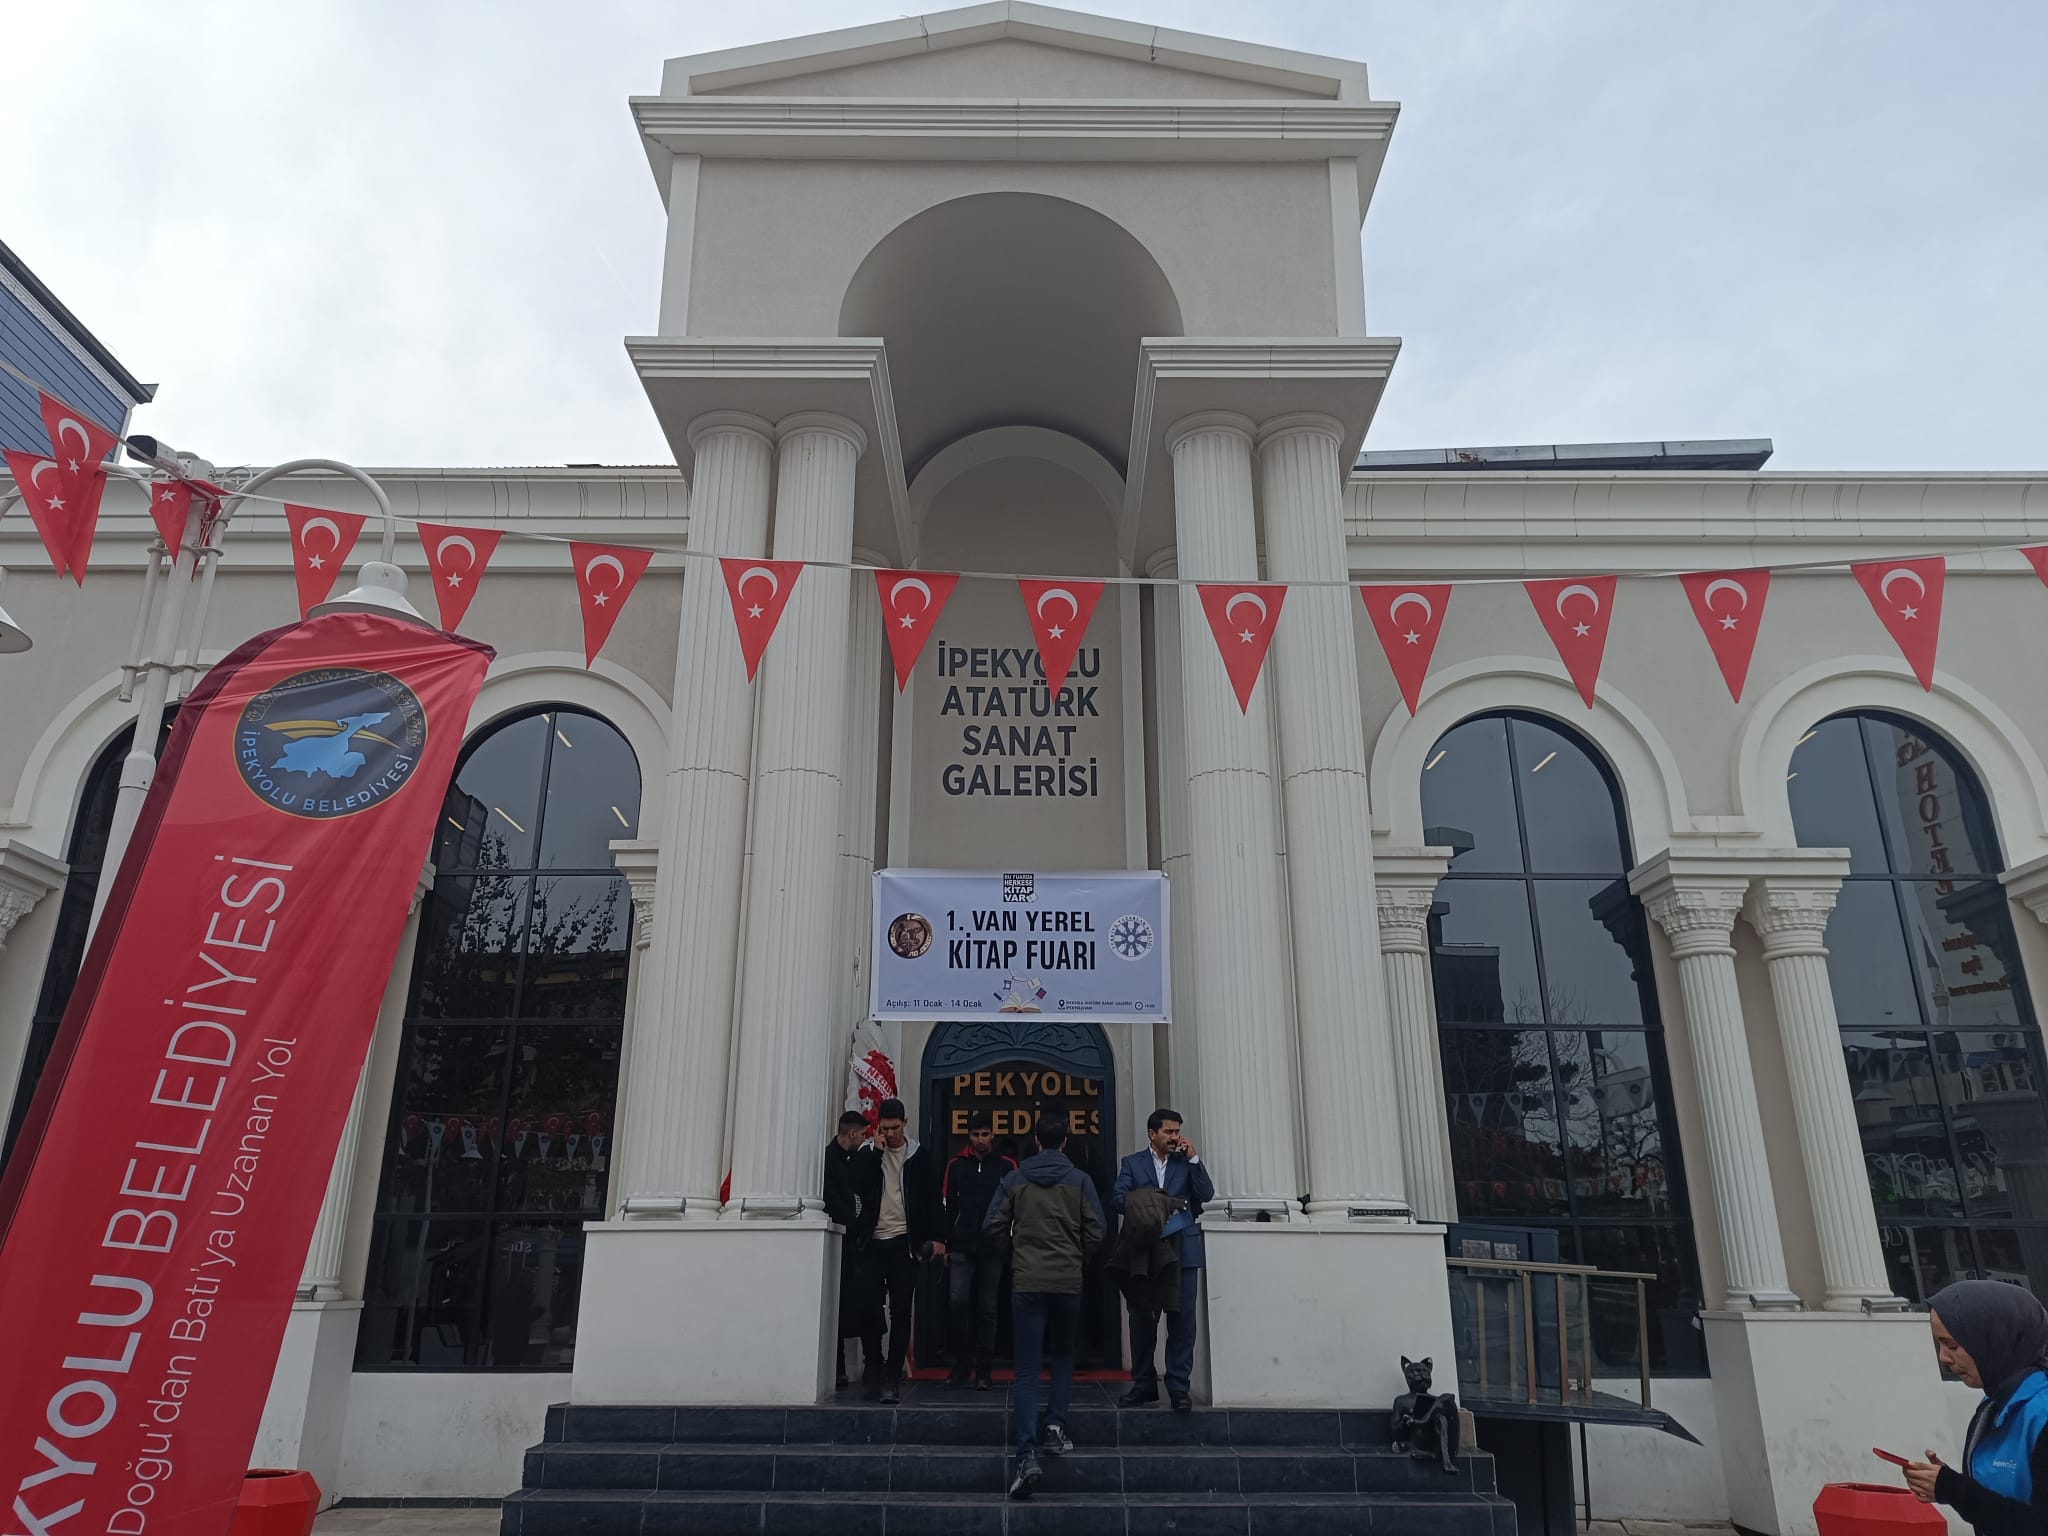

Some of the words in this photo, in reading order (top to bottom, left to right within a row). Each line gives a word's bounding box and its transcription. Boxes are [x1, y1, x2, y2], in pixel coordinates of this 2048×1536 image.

[941, 679, 1099, 717] ATATÜRK
[962, 725, 1077, 756] SANAT
[242, 730, 297, 805] İPEKYOLU
[302, 753, 413, 812] BELEDİYESİ
[942, 757, 1098, 797] GALERİSİ
[1004, 885, 1033, 894] KİTAP
[1004, 893, 1026, 902] VAR
[946, 910, 964, 931] 1.
[972, 910, 1017, 932] VAN
[1025, 911, 1095, 932] YEREL
[948, 932, 1018, 969] KİTAP
[1026, 940, 1096, 970] FUARI
[886, 999, 910, 1008] Açılış:
[913, 999, 920, 1007] 11
[923, 999, 943, 1007] Ocak
[951, 999, 960, 1007] 14
[963, 999, 983, 1008] Ocak
[102, 855, 293, 1253] BELEDİYESİ
[107, 1356, 197, 1535] Doğu'dan
[169, 1230, 236, 1341] Batı'ya
[210, 1096, 278, 1216] Uzanan
[251, 1037, 297, 1083] Yol
